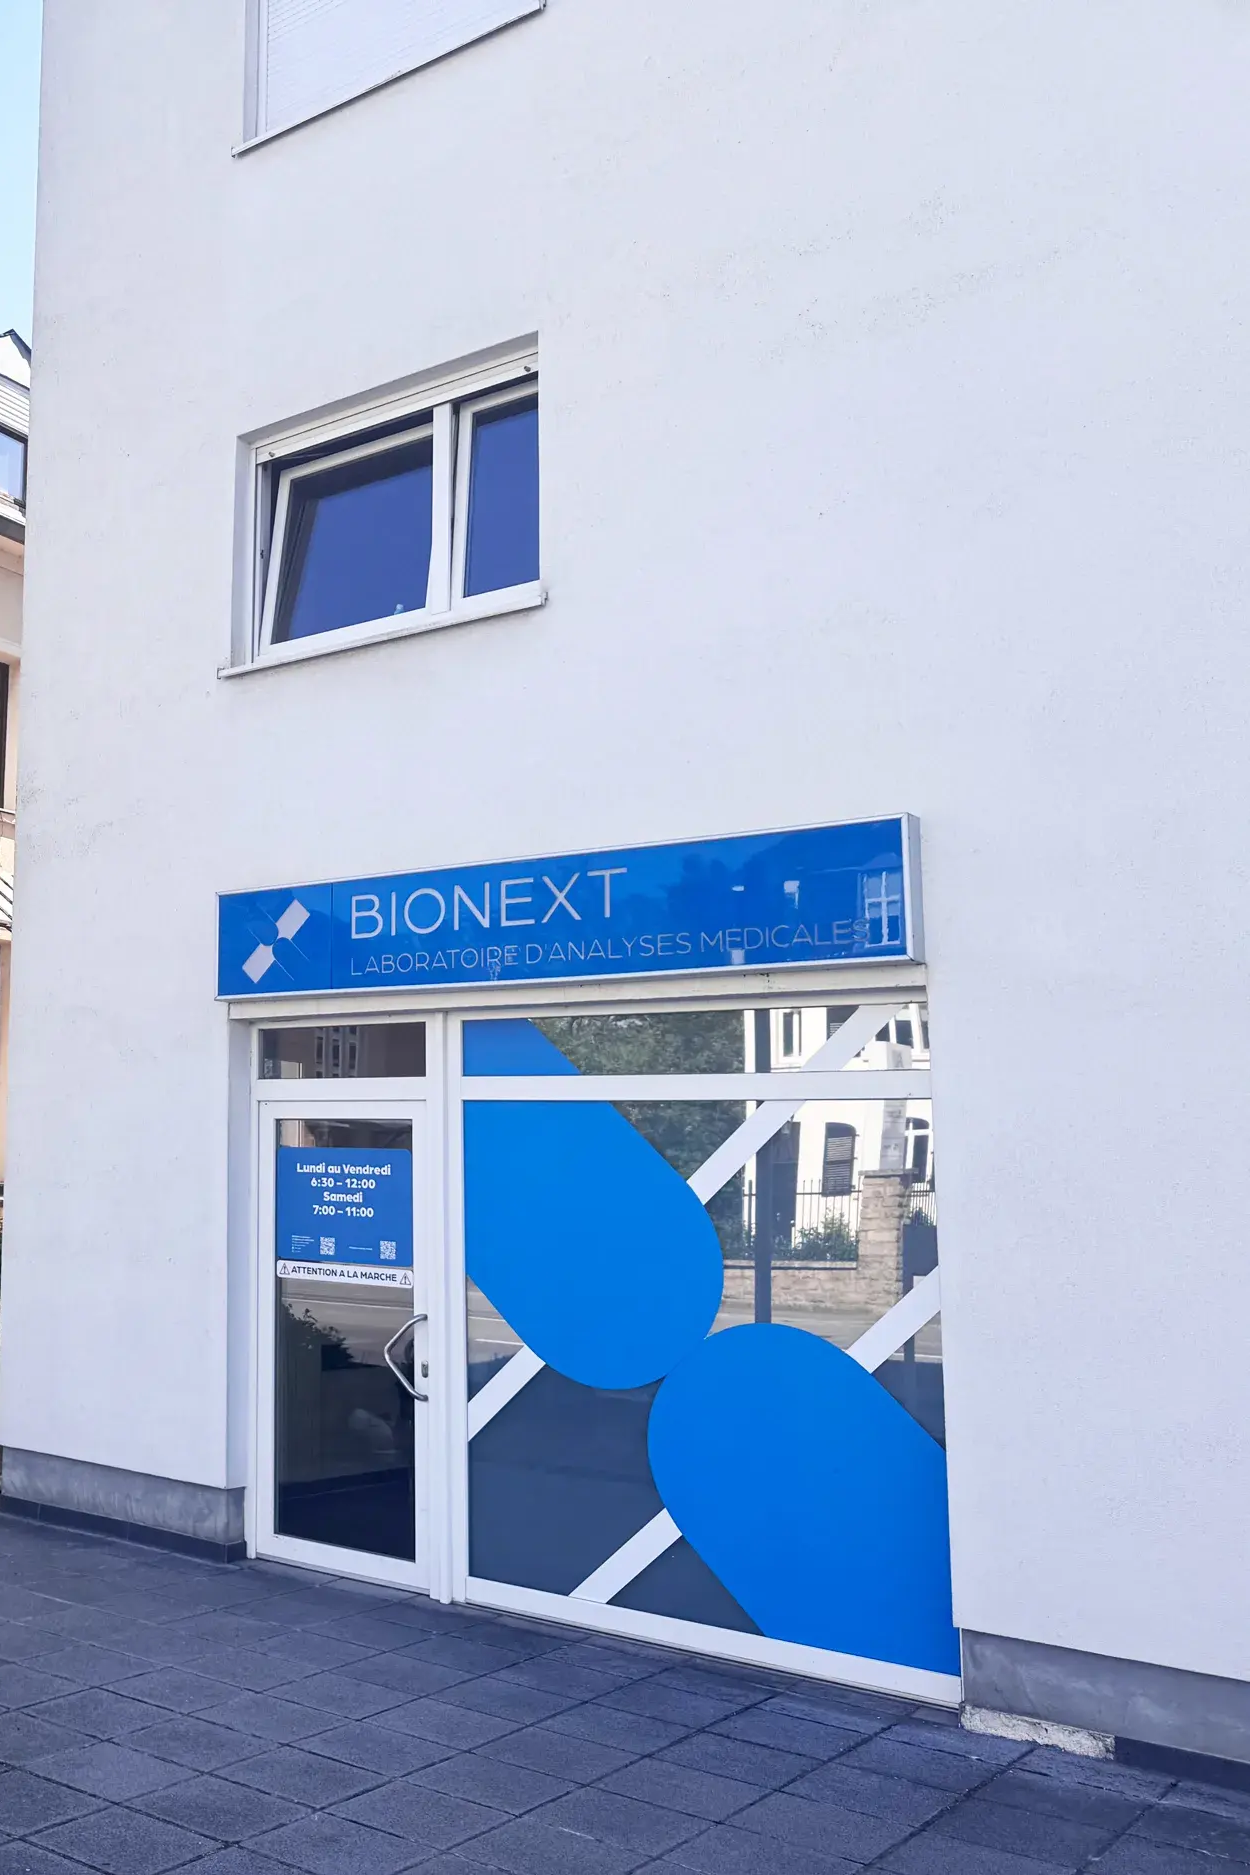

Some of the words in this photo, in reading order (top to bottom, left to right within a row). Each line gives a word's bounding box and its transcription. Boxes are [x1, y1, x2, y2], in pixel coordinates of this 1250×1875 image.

[349, 867, 628, 940] BIONEXT
[350, 946, 520, 976] LABORATOIRE
[525, 933, 692, 964] D'ANALYSES
[296, 1162, 325, 1174] Lundi
[327, 1166, 341, 1174] au
[342, 1164, 392, 1176] Vendredi
[310, 1177, 335, 1188] 6:30
[345, 1178, 376, 1189] 12:00
[323, 1191, 363, 1203] Samedi
[312, 1204, 336, 1216] 7:00
[345, 1207, 374, 1218] 11:00
[291, 1266, 338, 1277] ATTENTION
[339, 1269, 346, 1277] A
[347, 1269, 359, 1279] LA
[360, 1272, 397, 1282] MARCHE
